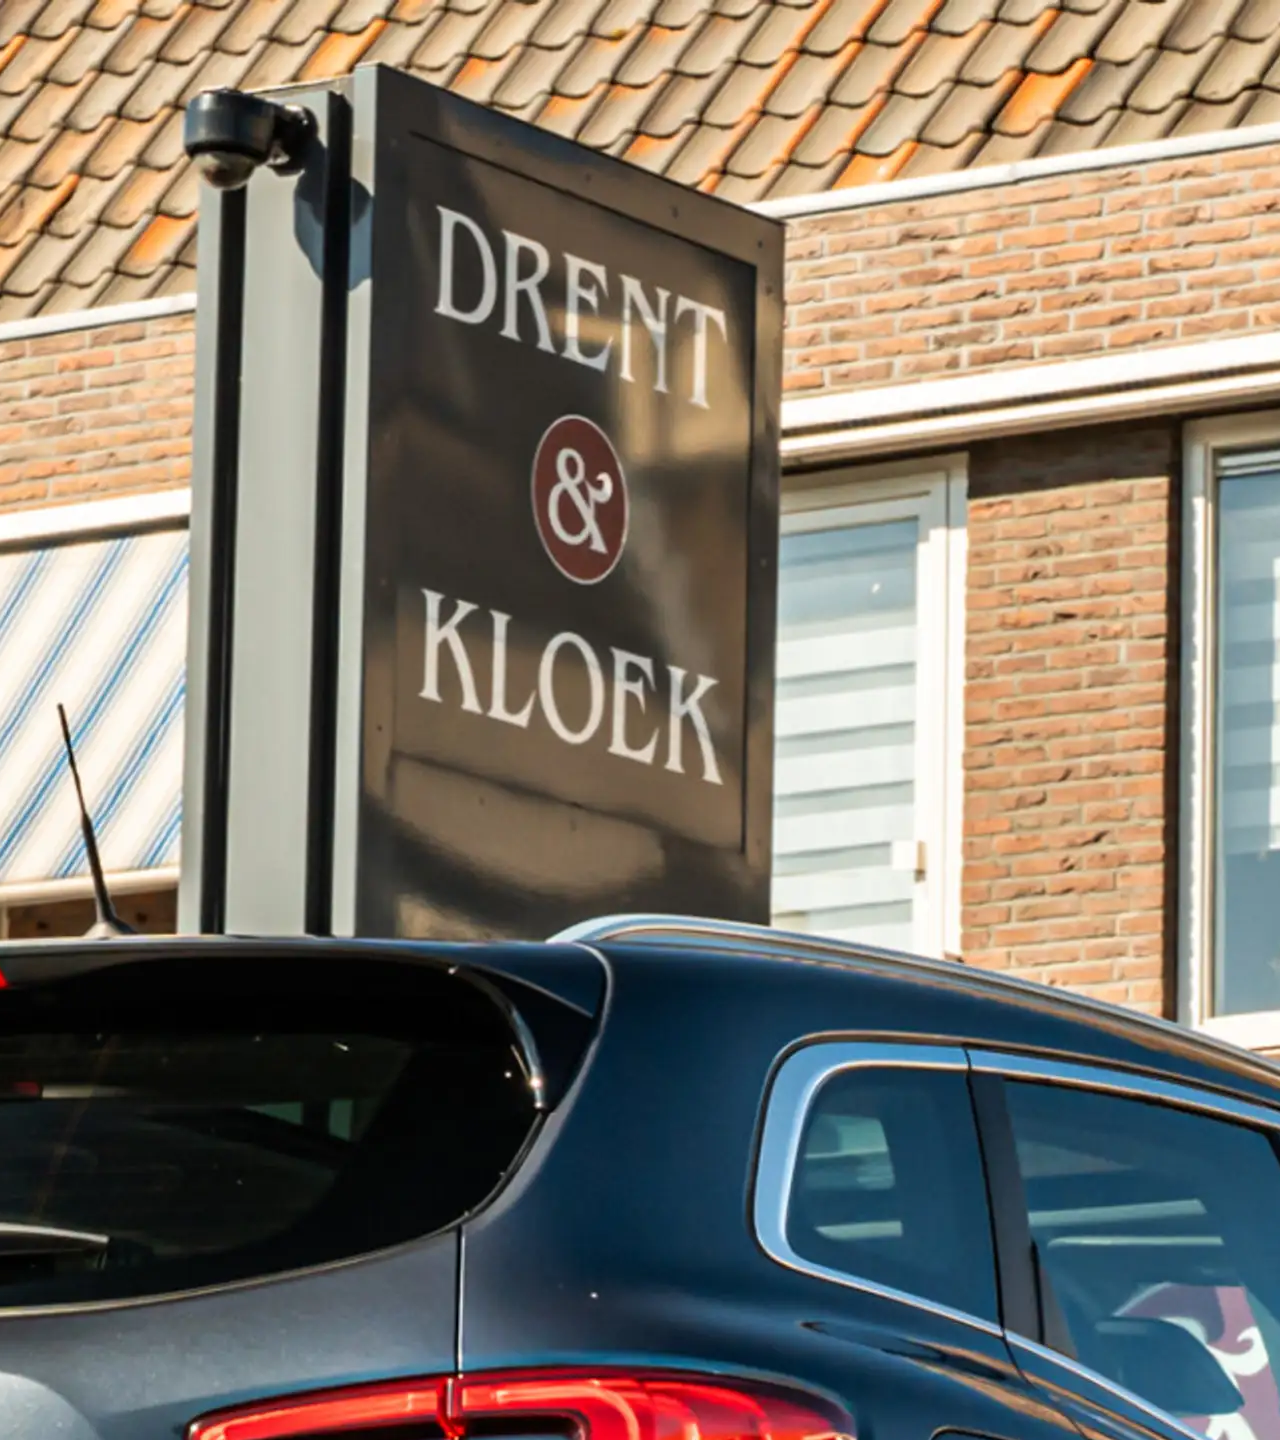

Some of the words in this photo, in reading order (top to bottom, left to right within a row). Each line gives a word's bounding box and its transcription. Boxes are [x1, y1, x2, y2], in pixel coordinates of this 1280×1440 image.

[434, 205, 727, 409] DRENT
[547, 447, 613, 555] &
[419, 588, 723, 785] KLOEK
